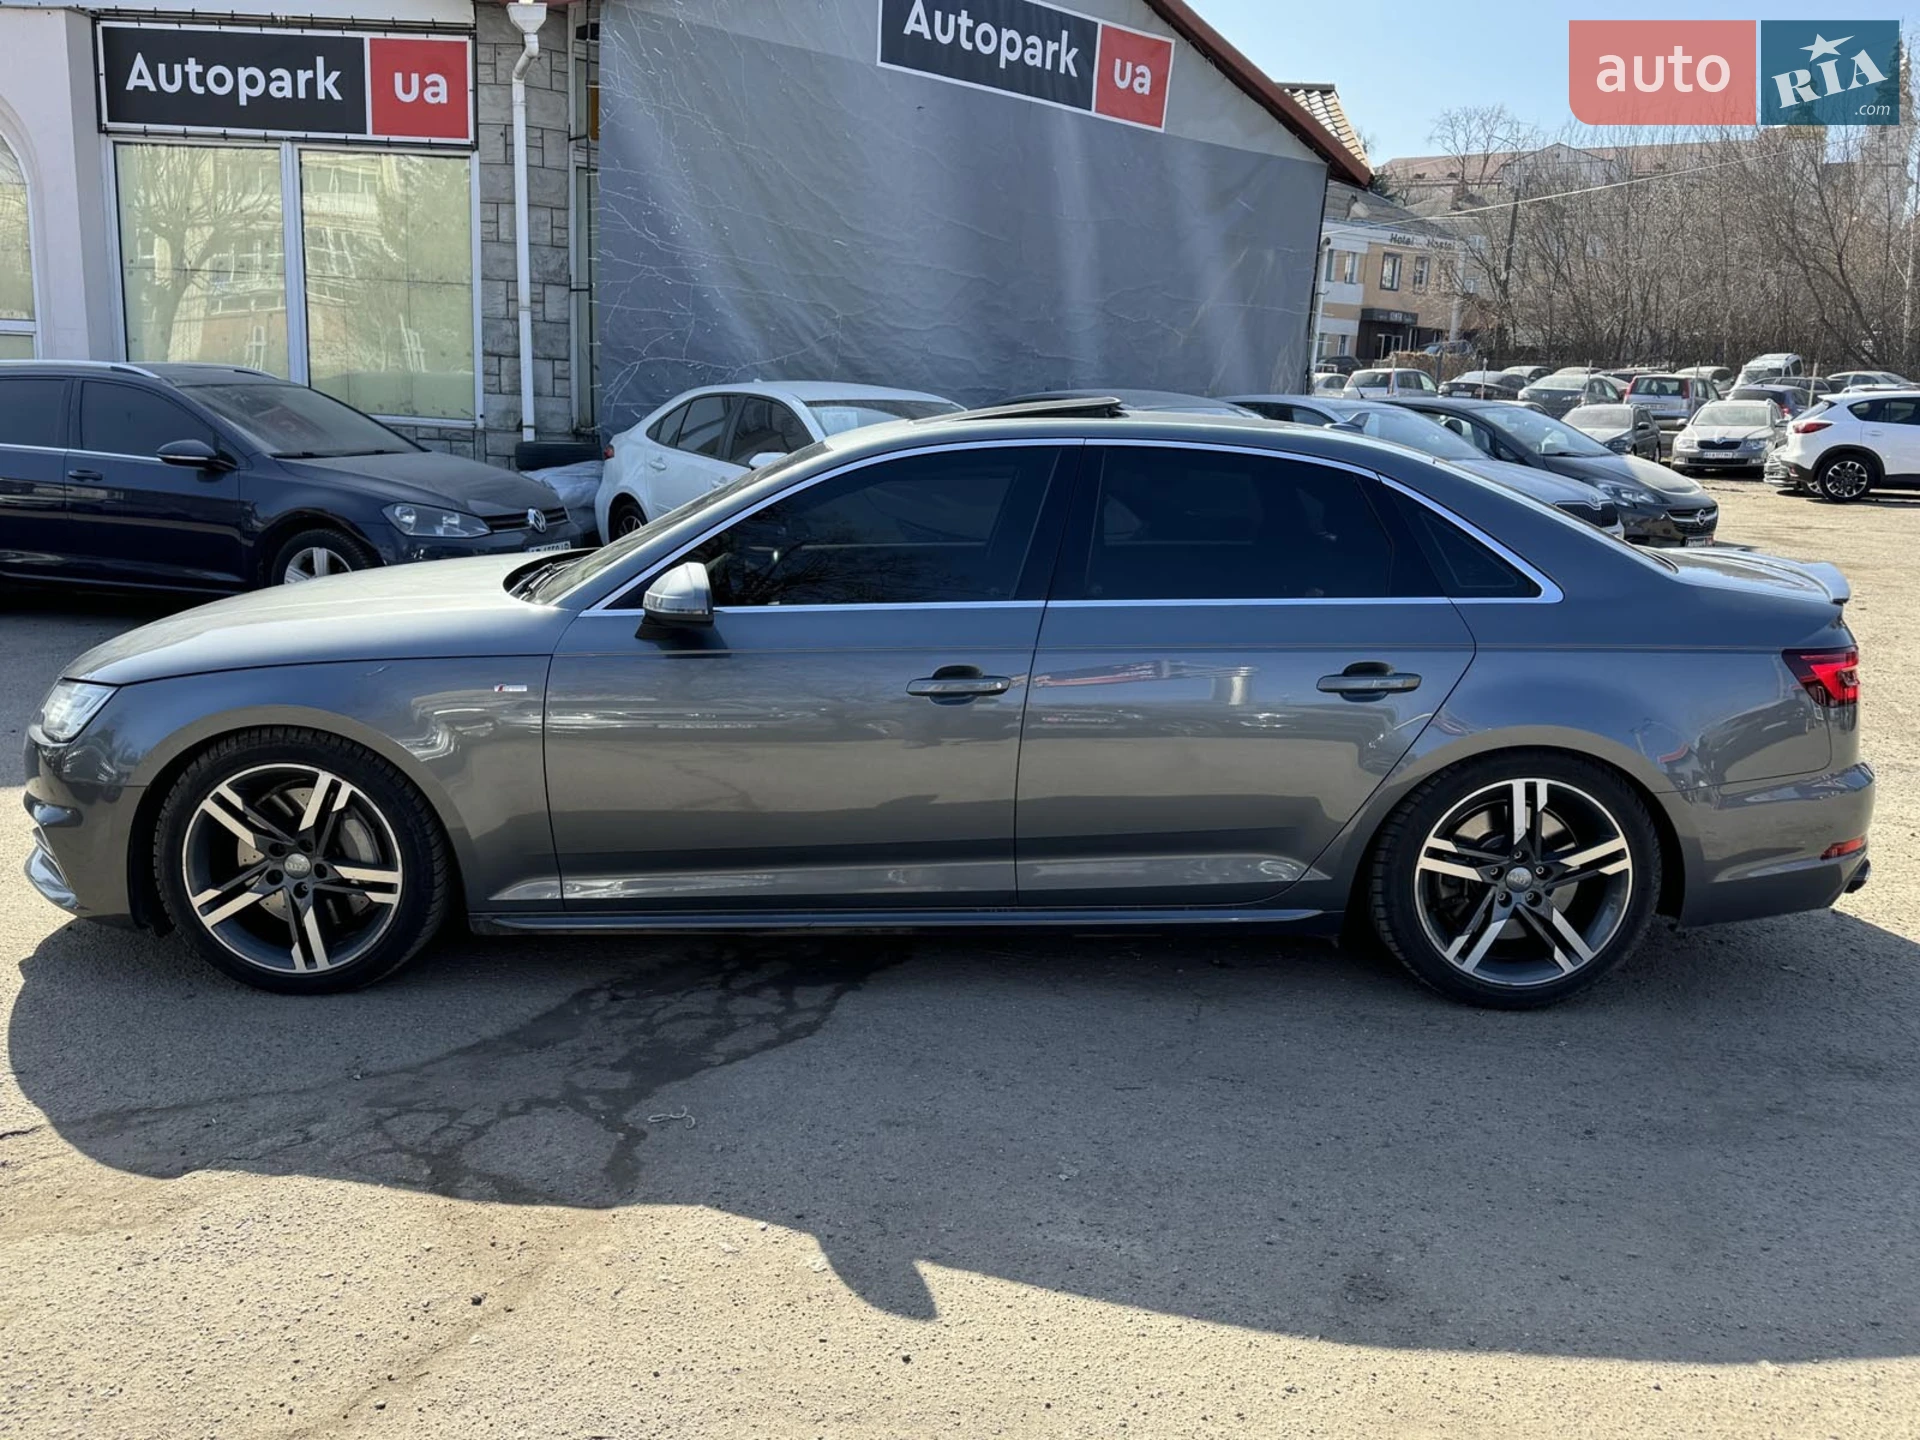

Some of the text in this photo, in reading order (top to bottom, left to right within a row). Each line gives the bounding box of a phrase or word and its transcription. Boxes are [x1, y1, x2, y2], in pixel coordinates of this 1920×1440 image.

[903, 0, 1152, 95] Autopark ua
[125, 52, 448, 106] Autopark ua
[1390, 233, 1414, 246] Hotel
